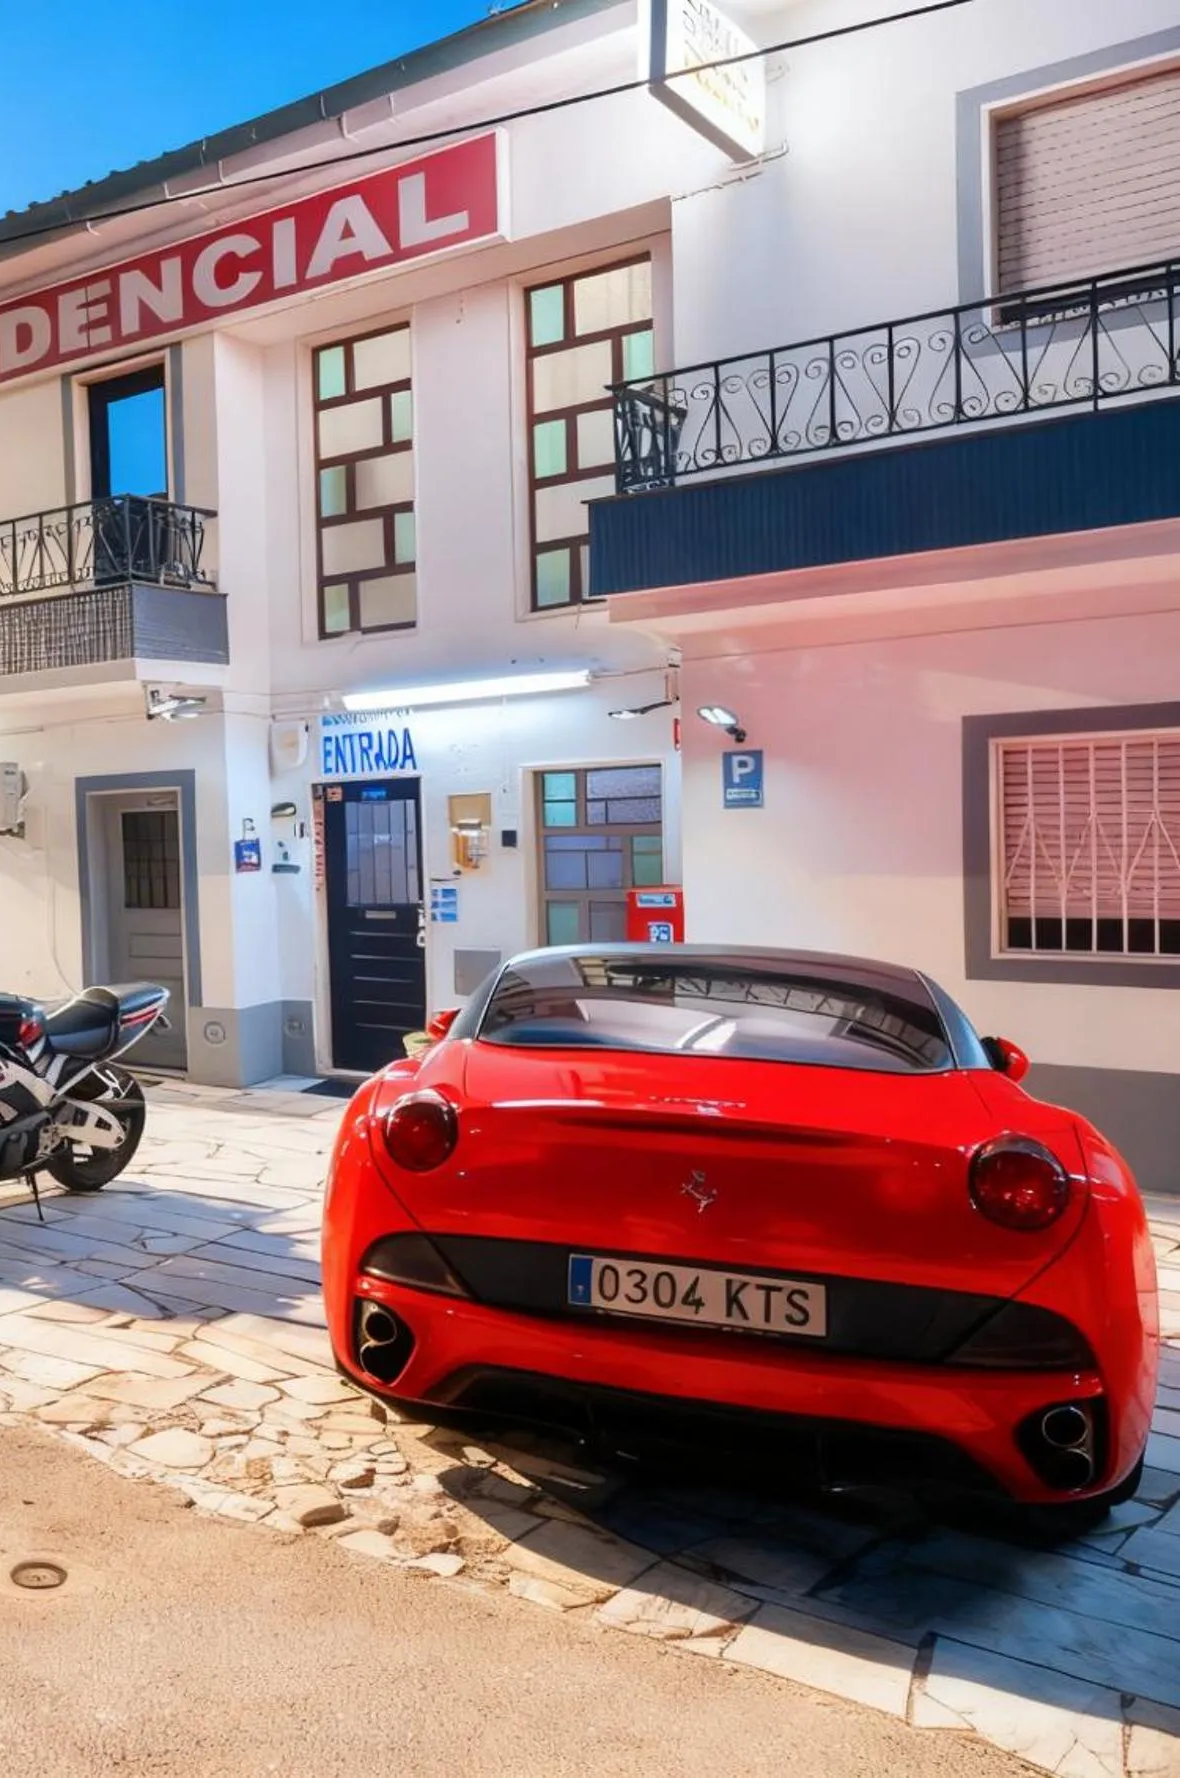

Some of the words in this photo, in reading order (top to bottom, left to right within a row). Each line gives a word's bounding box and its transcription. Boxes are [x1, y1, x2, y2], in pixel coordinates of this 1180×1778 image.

[323, 727, 417, 774] ENTRADA
[731, 754, 756, 784] P
[598, 1264, 705, 1315] 0304
[725, 1278, 810, 1327] KTS
